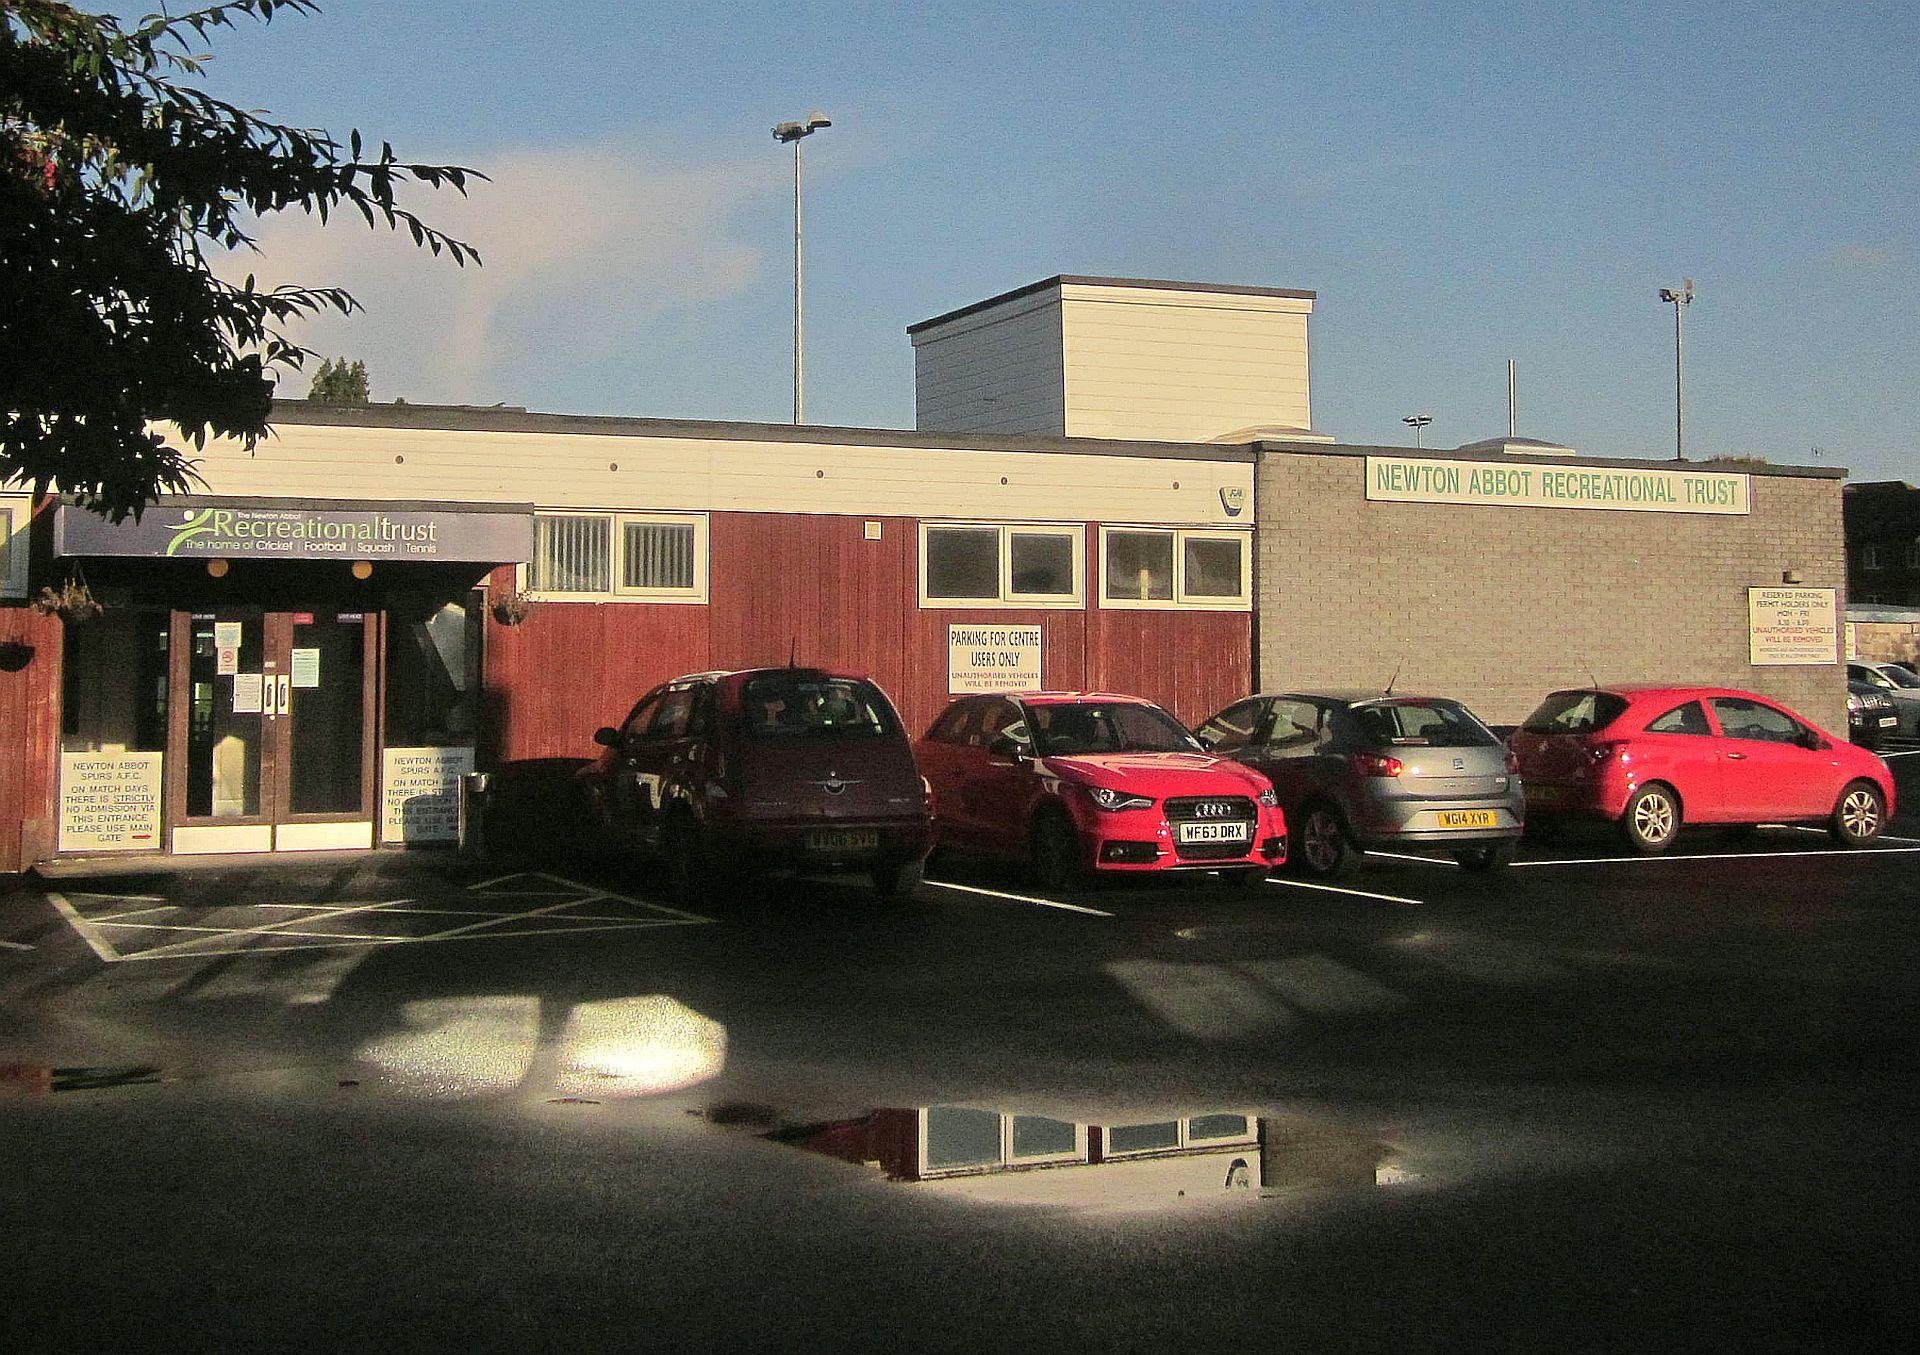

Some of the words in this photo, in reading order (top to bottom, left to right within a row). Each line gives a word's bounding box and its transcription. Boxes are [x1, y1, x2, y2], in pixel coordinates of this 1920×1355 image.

[1377, 463, 1460, 494] NEWTON
[1469, 469, 1532, 497] ABBOT
[1542, 472, 1676, 502] RECREATIONAL
[1684, 478, 1738, 505] TRUST
[186, 539, 204, 549] The
[207, 540, 240, 550] home
[242, 540, 253, 549] of
[256, 540, 293, 551] Cricket
[304, 541, 347, 552] Football
[357, 542, 395, 554] Squash
[405, 542, 437, 554] Tennis
[951, 630, 987, 647] PARKING
[990, 631, 1006, 646] FOR
[1009, 631, 1039, 646] CENTRE
[971, 651, 996, 667] USERS
[998, 651, 1020, 667] ONLY
[73, 762, 114, 770] NEWTON
[118, 761, 150, 769] ABBOT
[394, 757, 431, 765] NEWTON
[81, 772, 112, 780] SPURS
[393, 779, 406, 787] ON
[90, 785, 120, 793] MATCH
[65, 795, 95, 803] THERE
[100, 795, 109, 803] IS
[114, 794, 155, 803] STRICTLY
[387, 798, 400, 806] NO
[66, 805, 79, 813] NO
[73, 815, 93, 823] THIS
[98, 814, 148, 822] ENTRANCE
[1444, 815, 1468, 825] WG14
[1471, 813, 1489, 824] XYR
[66, 825, 103, 833] PLEASE
[1221, 825, 1242, 838] DRX
[97, 834, 121, 842] GATE
